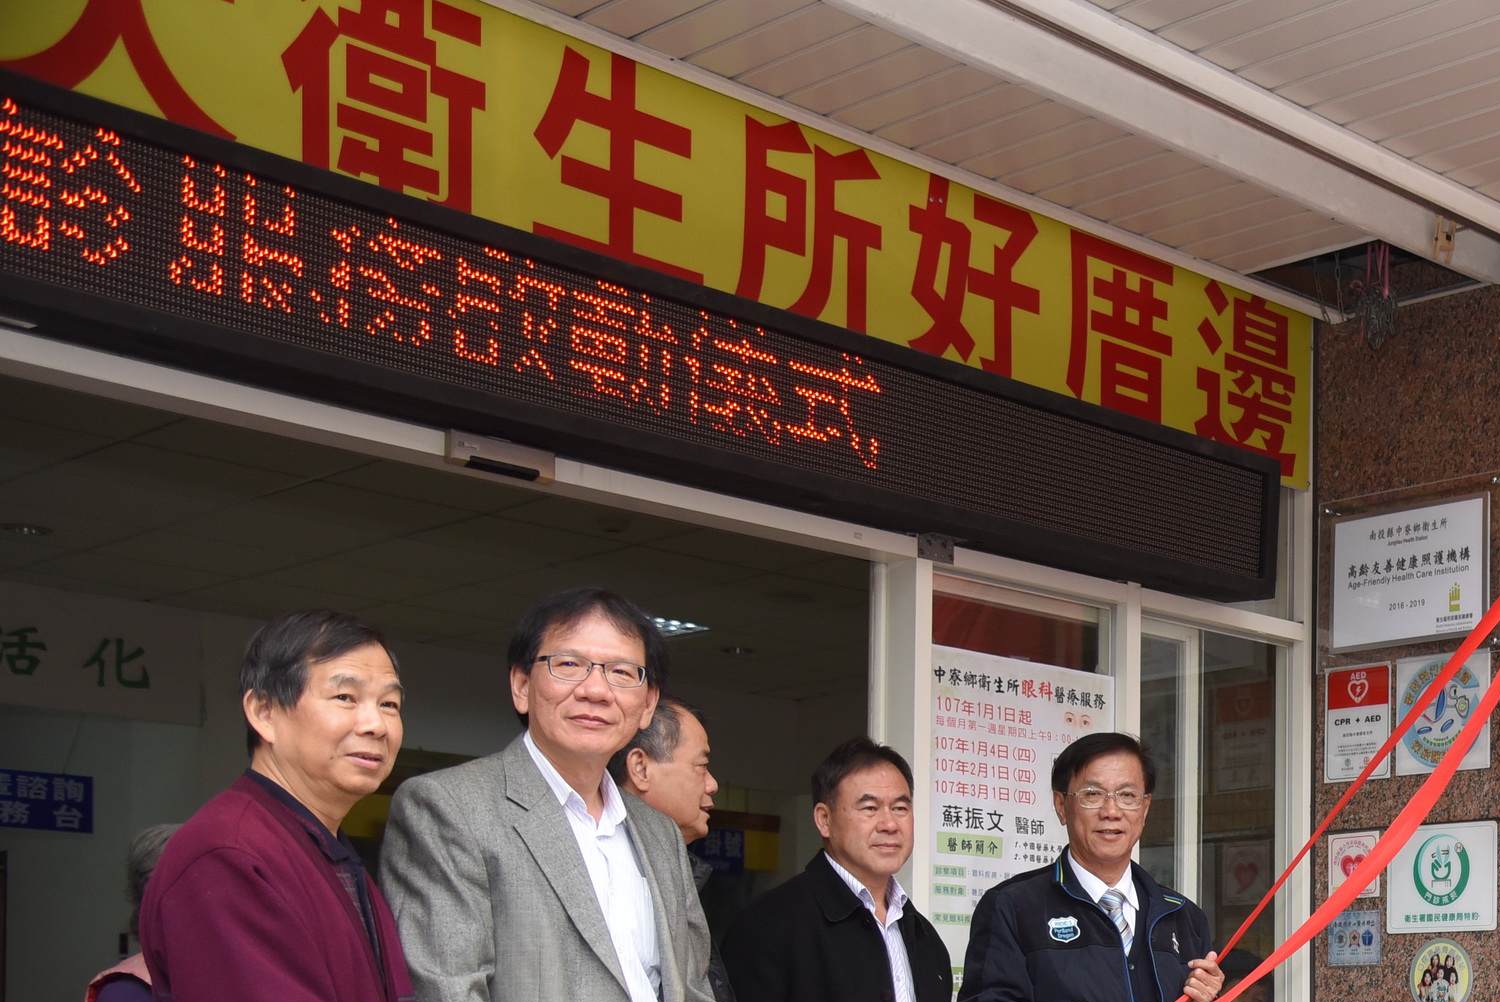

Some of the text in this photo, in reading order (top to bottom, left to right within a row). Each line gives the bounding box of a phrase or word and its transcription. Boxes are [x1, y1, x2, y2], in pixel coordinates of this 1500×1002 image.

[1348, 546, 1471, 579] 高齡友善健康照護機構
[1348, 563, 1470, 590] Age-Friendly Health Care Institution
[934, 665, 1107, 711] 中寮鄉衛生所眼科醫療服務
[1350, 671, 1367, 680] AED
[937, 696, 1033, 726] 107年1月1日起
[1334, 718, 1351, 727] CPR
[1364, 714, 1382, 723] AED
[934, 736, 1037, 764] 107年1月4日(四)
[934, 758, 1037, 784] 107年2月1日(四)
[934, 780, 1037, 806] 107年3月1日(四)
[942, 804, 1045, 837] 蘇振文 醫師
[947, 837, 999, 855] 醫師簡介
[1404, 912, 1479, 923] 衛生署國民健康局特約
